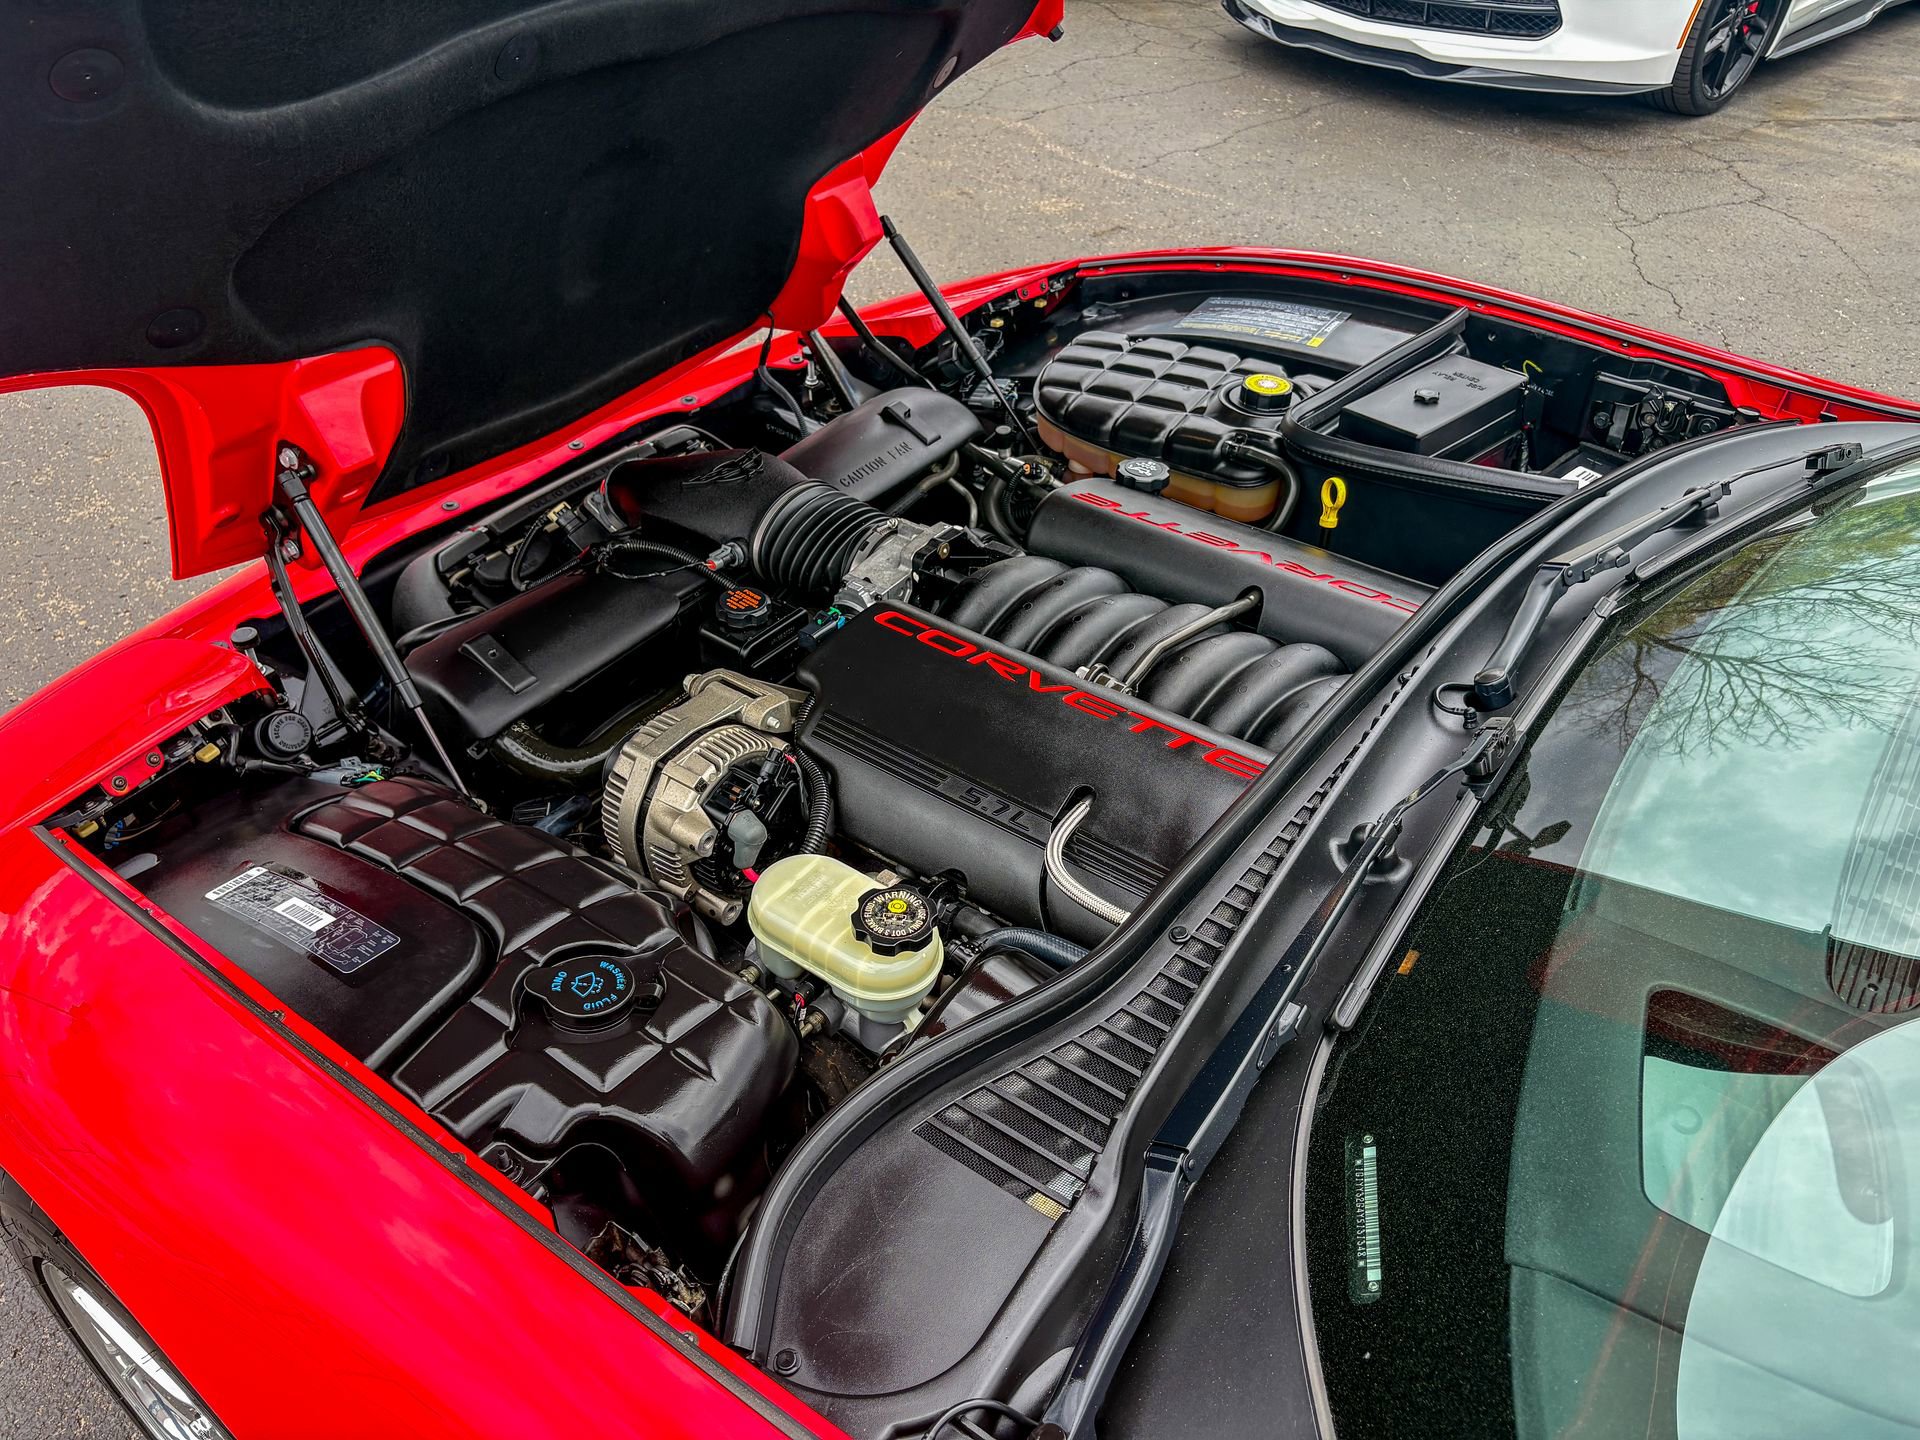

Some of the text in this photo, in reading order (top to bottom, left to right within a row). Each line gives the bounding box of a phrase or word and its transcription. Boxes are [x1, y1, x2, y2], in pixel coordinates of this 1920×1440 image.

[1452, 371, 1480, 383] CENTER
[839, 456, 888, 488] CAUTION
[1071, 492, 1421, 614] CORVETTE
[873, 609, 1268, 780] CORVETTE
[959, 786, 1030, 832] 5.7L
[873, 890, 922, 907] WARNING
[863, 902, 875, 918] FLUID
[917, 909, 927, 920] USE
[865, 918, 883, 934] BRAKE
[891, 929, 907, 937] DOT
[908, 920, 924, 934] ONLY
[551, 960, 625, 1011] WASHER FLUID ONLY
[1355, 1167, 1366, 1257] 1G1YY32G4Y5131348
